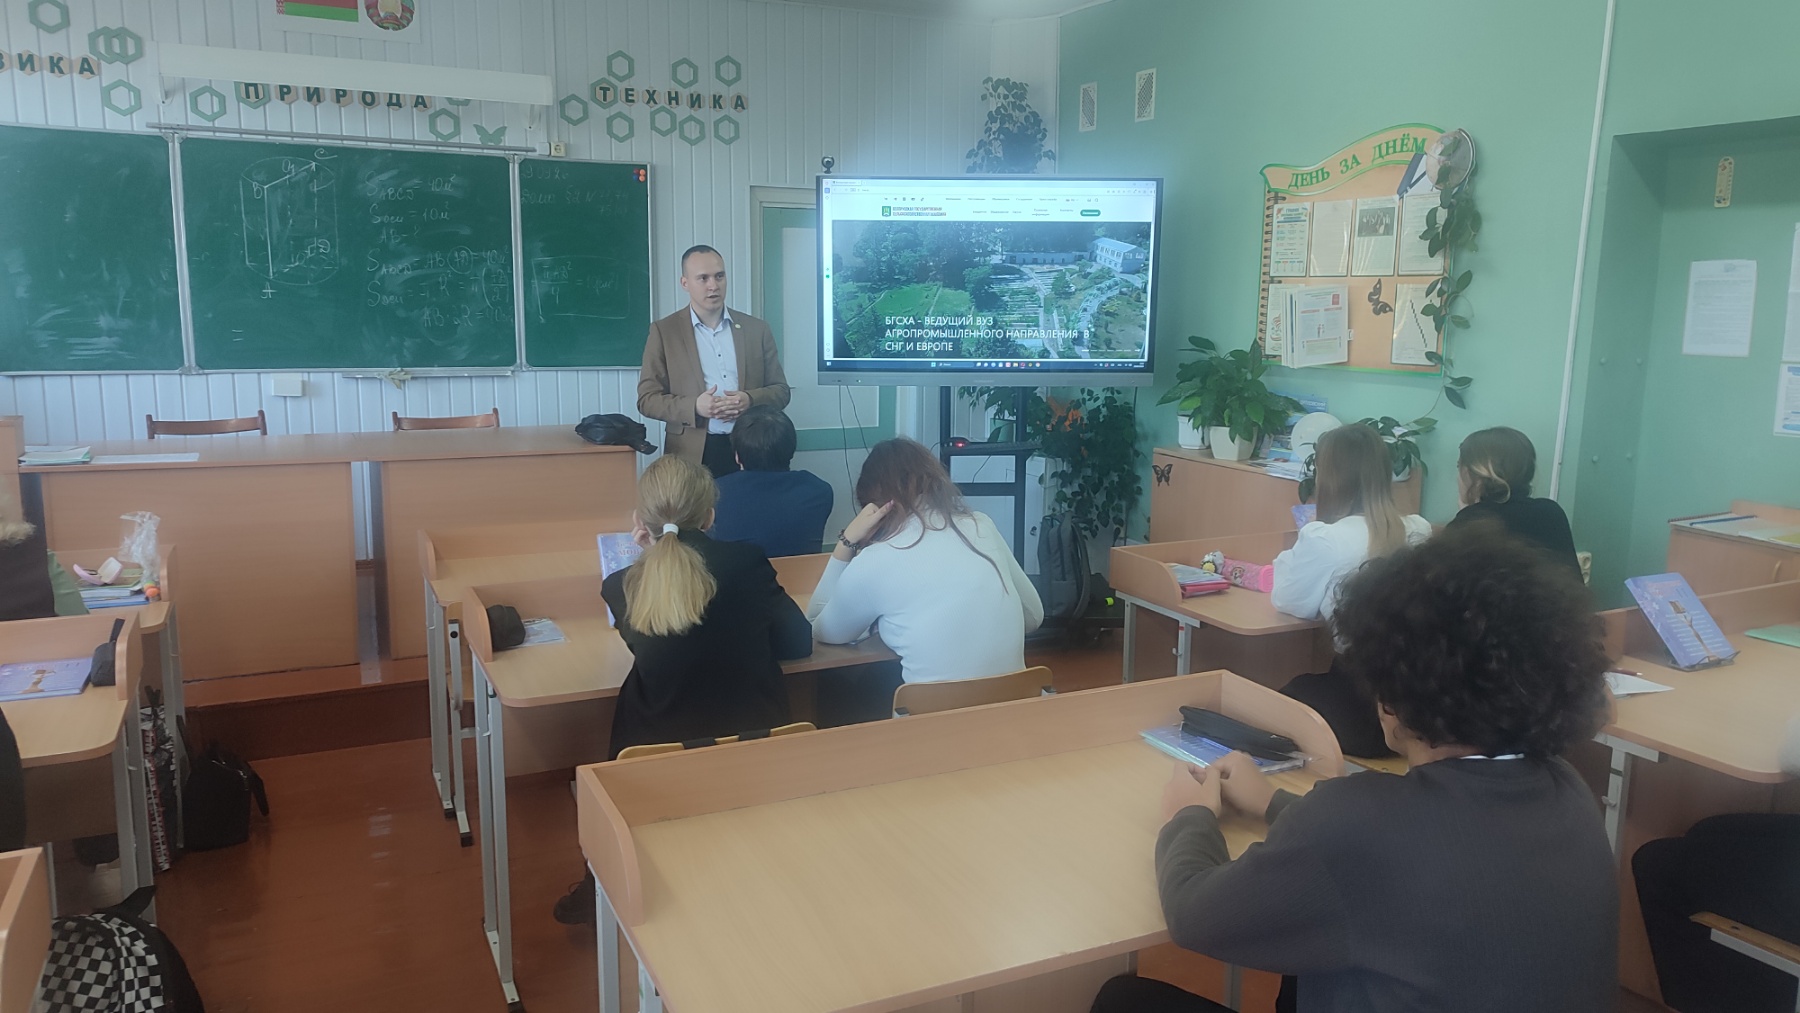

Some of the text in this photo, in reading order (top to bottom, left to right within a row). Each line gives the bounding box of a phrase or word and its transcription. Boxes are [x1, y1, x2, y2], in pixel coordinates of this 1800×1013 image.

[244, 82, 428, 109] ПРИРОДА
[599, 86, 746, 110] ТЕХНИКА
[1288, 133, 1428, 190] ДЕНЬ ЗА ДНЁМ
[885, 316, 916, 326] БГСХА
[924, 315, 974, 327] ВЕДУЩИЙ
[976, 316, 994, 326] ВУЗ
[885, 329, 1090, 339] АГРОПРОМЫШЛЕННОГО НАПРАВЛЕНИЯ В
[885, 341, 954, 351] СНГ И ЕВРОПЕ
